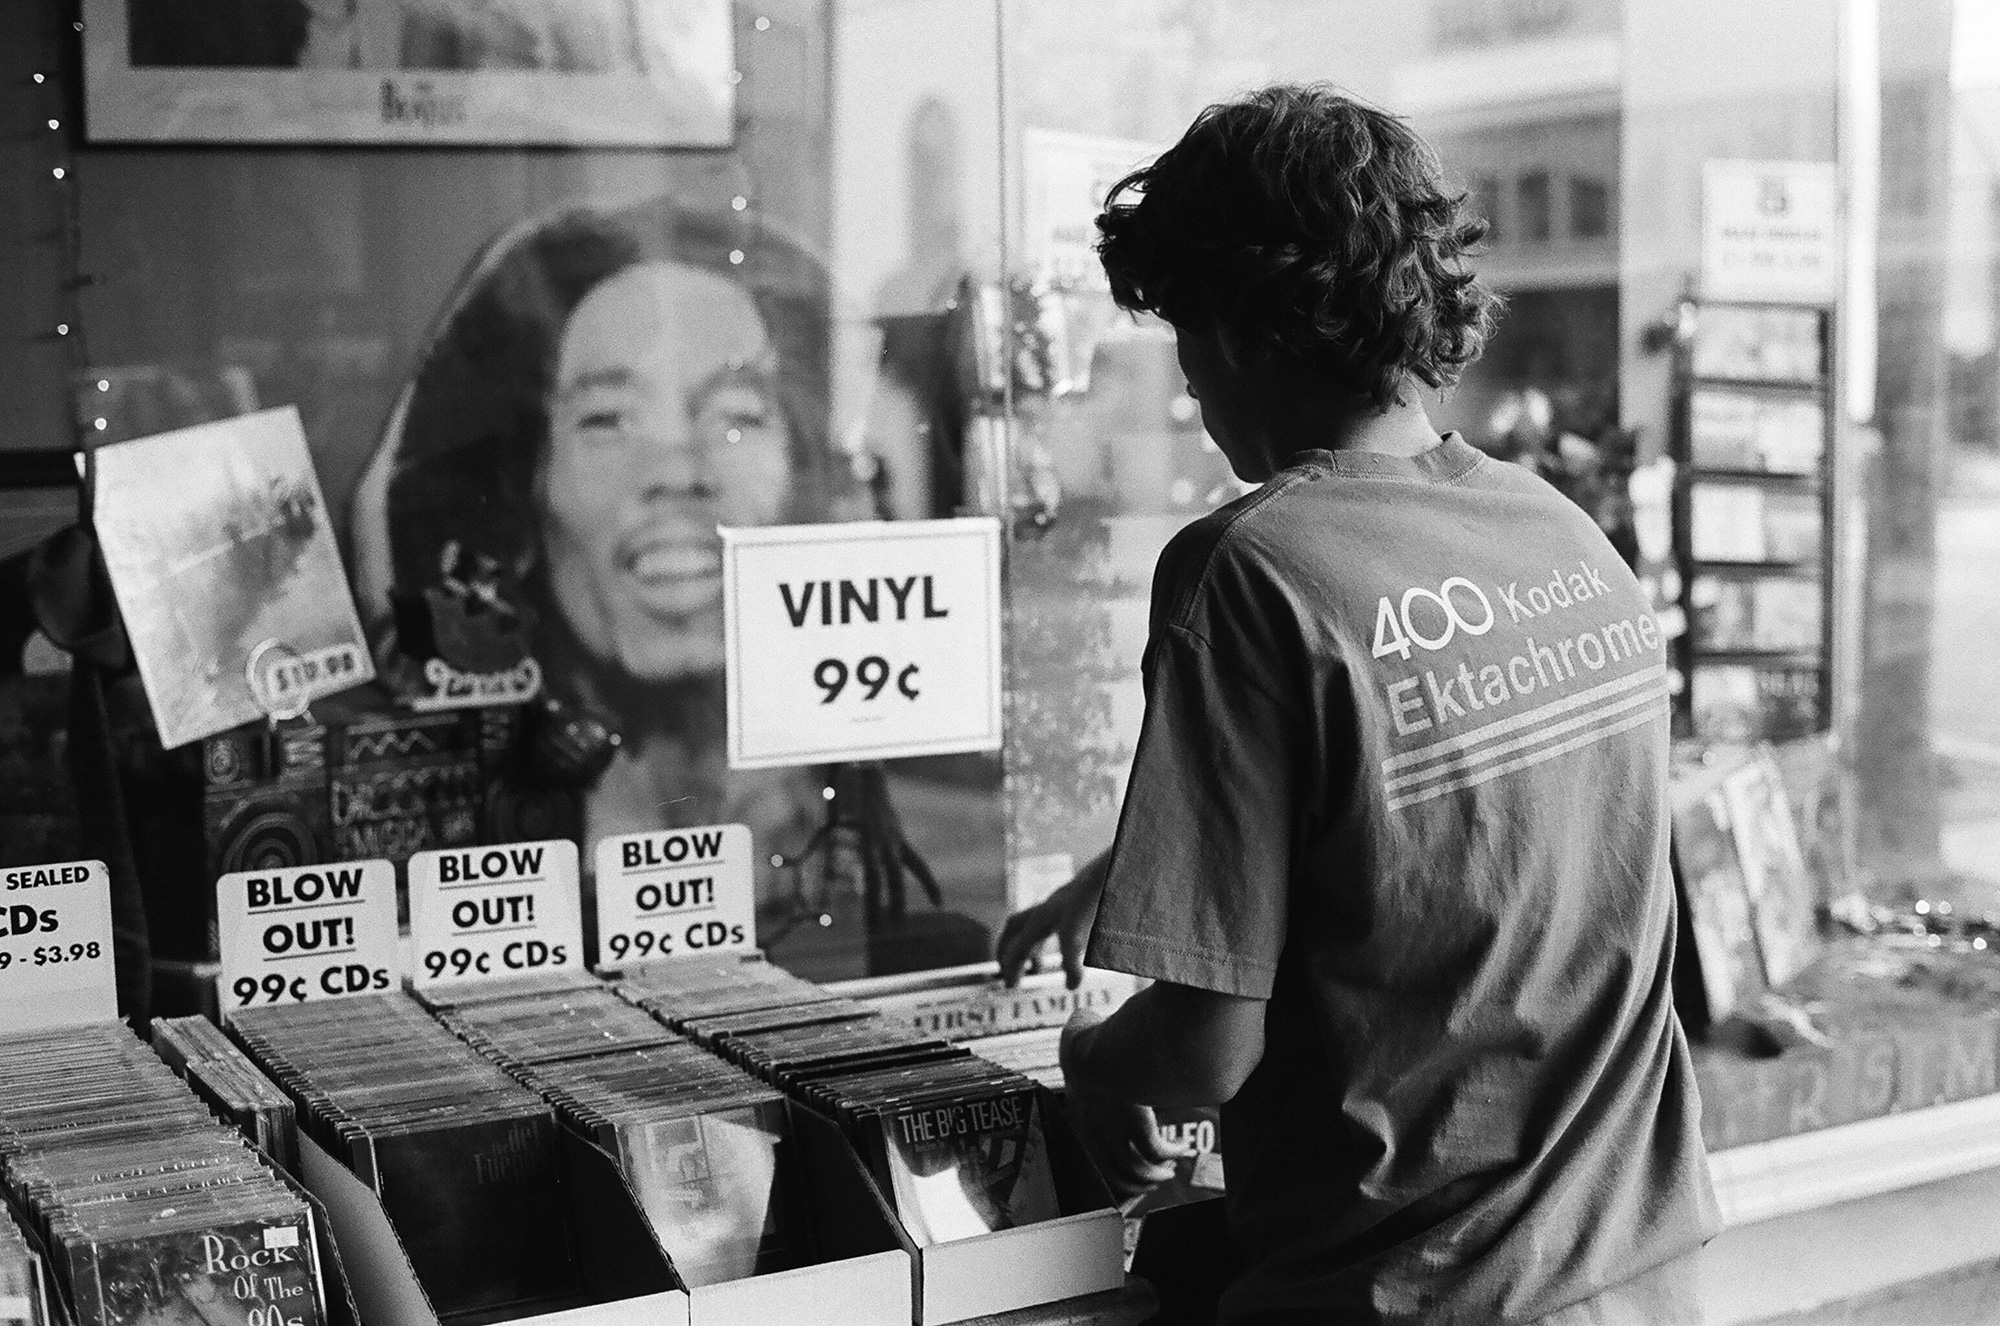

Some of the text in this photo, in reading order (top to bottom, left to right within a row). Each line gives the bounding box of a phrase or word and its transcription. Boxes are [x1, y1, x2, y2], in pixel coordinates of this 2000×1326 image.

[779, 575, 949, 627] VINYL
[1372, 561, 1612, 660] 400 Kodak
[814, 655, 920, 705] 99¢
[1386, 613, 1661, 737] Ektachrome
[439, 848, 543, 883] BLOW
[622, 831, 723, 868] BLOW
[6, 866, 90, 891] SEALED
[247, 869, 363, 908] BLOW
[635, 877, 714, 911] OUT!
[452, 895, 534, 928] OUT!
[263, 917, 354, 953] OUT!
[609, 921, 745, 960] 99¢ CDs
[34, 942, 101, 967] $3.98
[424, 941, 567, 978] 99¢ CDs
[233, 964, 390, 1006] 99¢ CDs
[898, 1096, 1025, 1143] THE BIG TEASE
[234, 1273, 304, 1300] Of The
